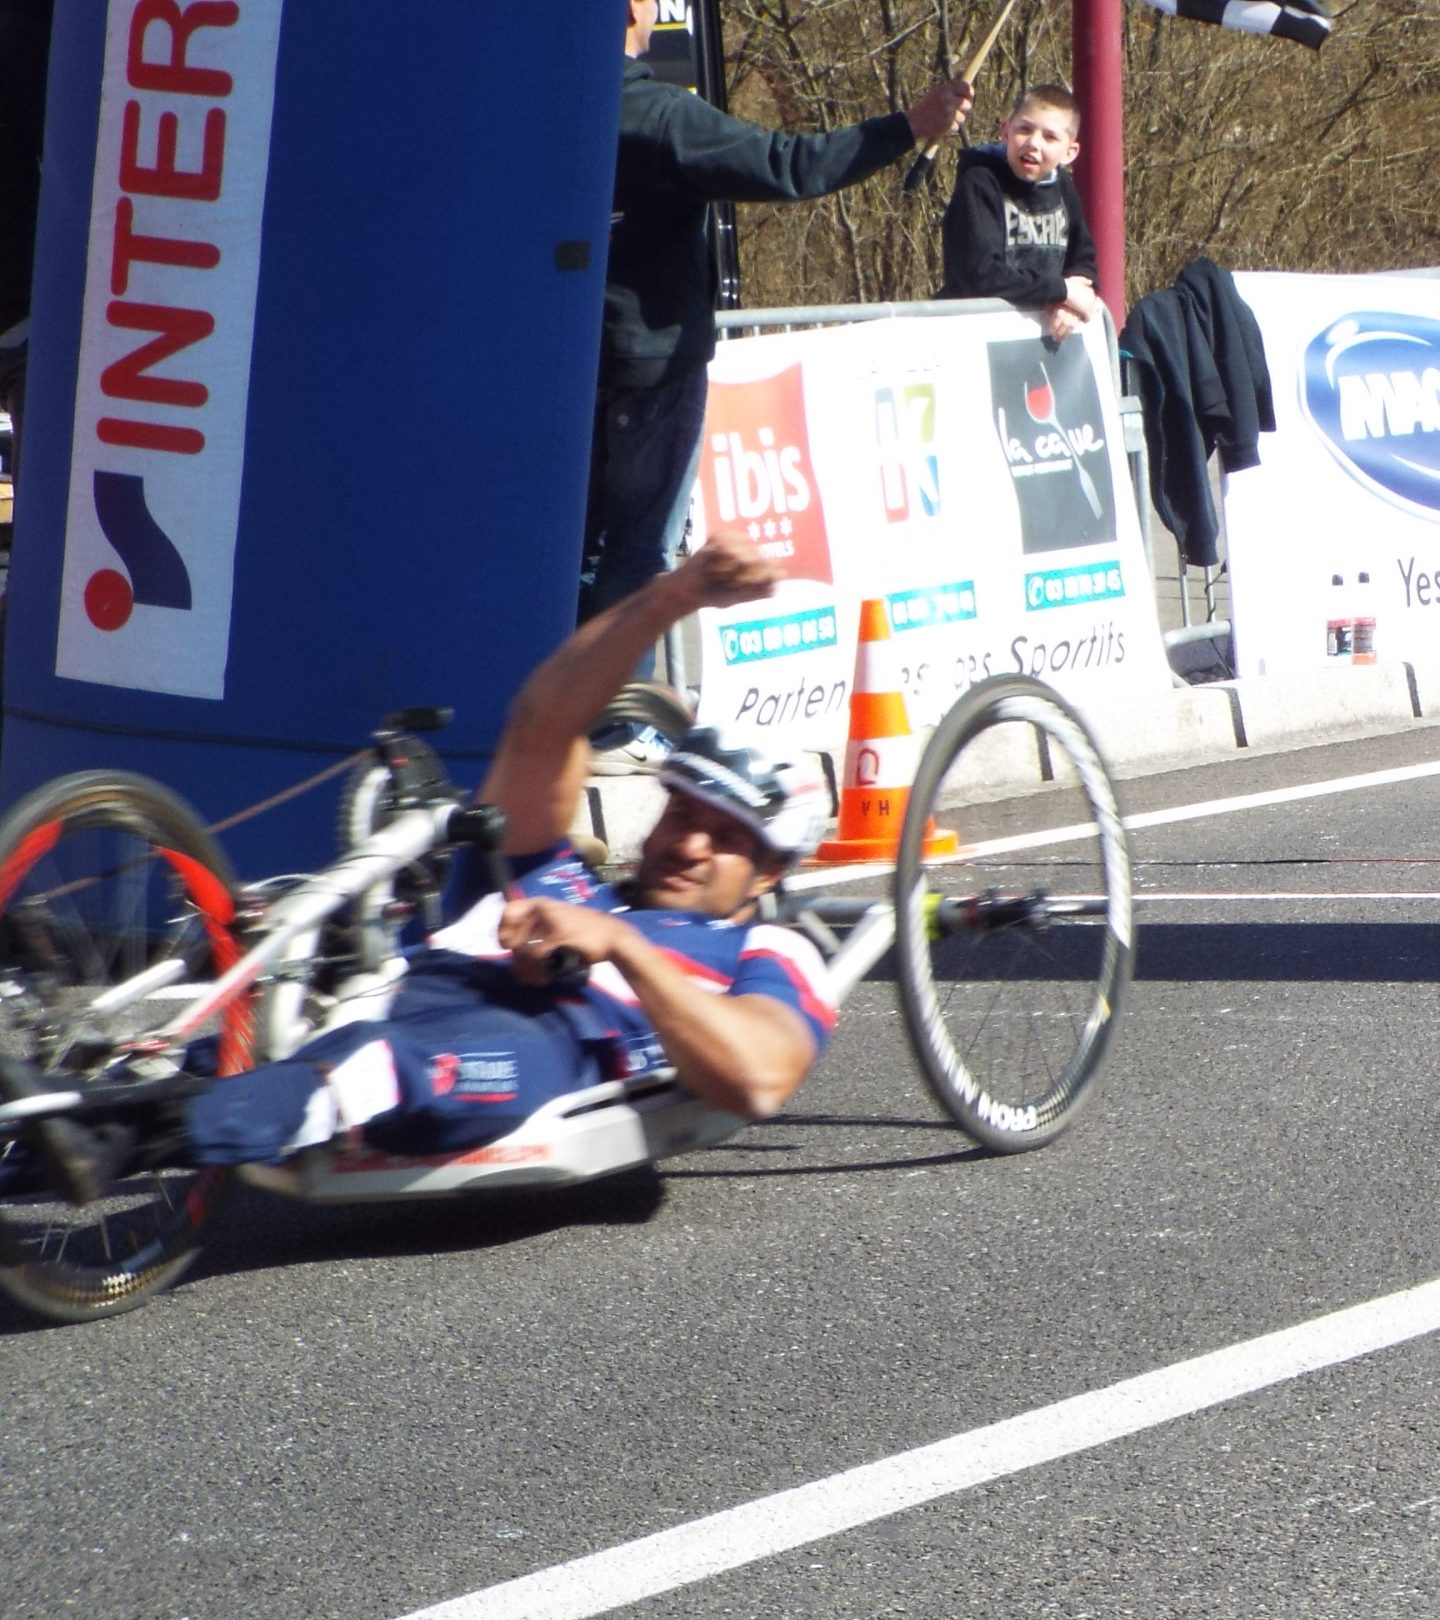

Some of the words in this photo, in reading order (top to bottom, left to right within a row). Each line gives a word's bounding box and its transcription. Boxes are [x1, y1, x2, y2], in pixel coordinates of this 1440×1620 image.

[998, 407, 1033, 463] la
[1034, 423, 1105, 459] cave
[711, 428, 810, 522] ibis
[1009, 621, 1128, 676] Sportifs
